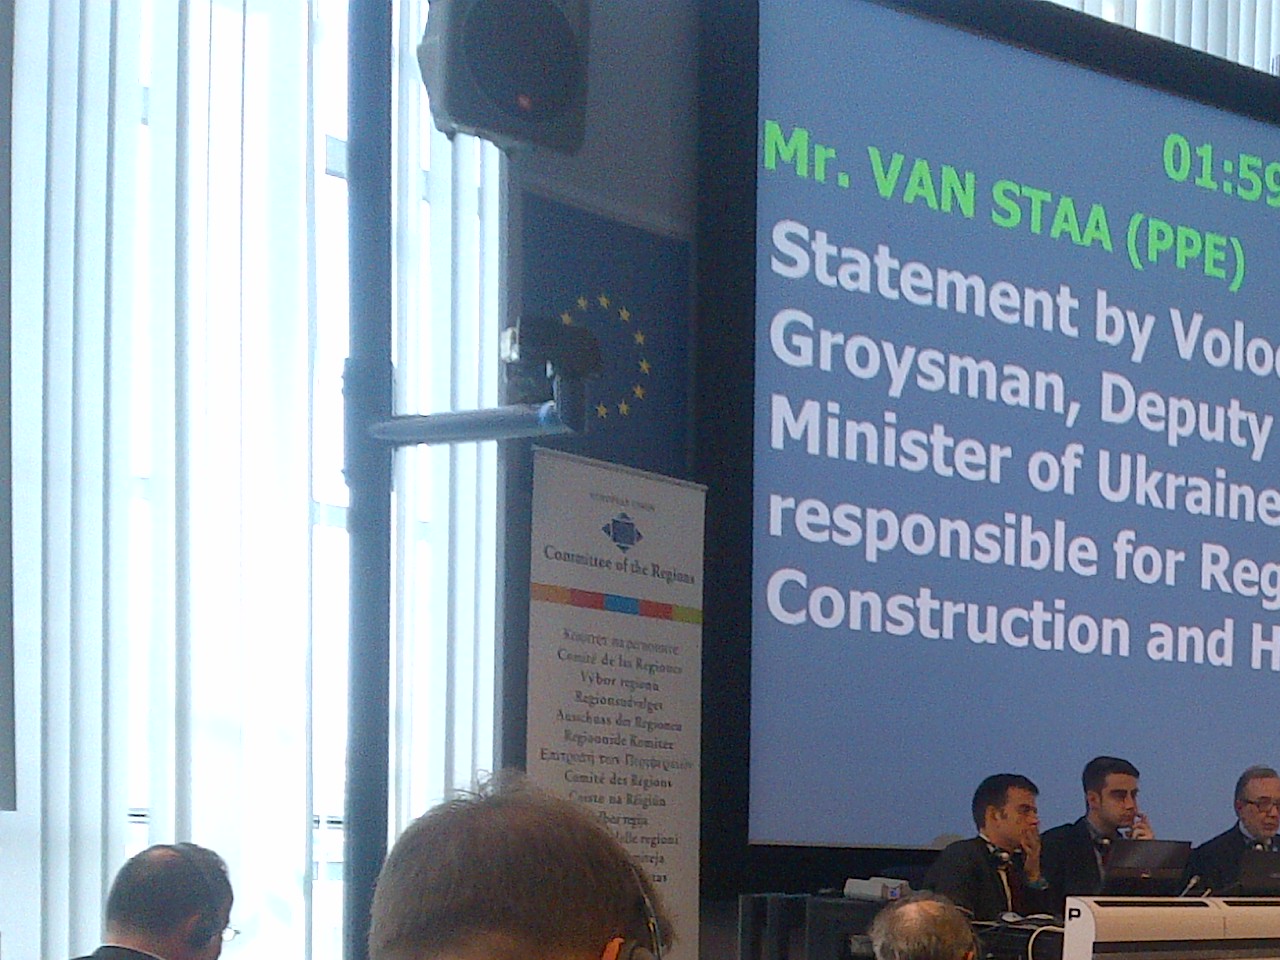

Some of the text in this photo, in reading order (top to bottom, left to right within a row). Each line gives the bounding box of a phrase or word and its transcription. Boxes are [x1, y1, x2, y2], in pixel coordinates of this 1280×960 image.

[763, 120, 1247, 292] Mr. VAN STAA (PPE)
[770, 219, 1079, 338] Statement
[1095, 288, 1155, 363] by
[769, 308, 1081, 427] Groysman,
[1101, 371, 1274, 461] Deputy
[770, 393, 1012, 484] Minister
[1028, 441, 1084, 494] of
[544, 545, 695, 585] Committee of the Regions
[768, 491, 1098, 575] responsible
[1112, 530, 1186, 586] for
[766, 567, 1130, 656] Construction
[1146, 619, 1234, 668] and
